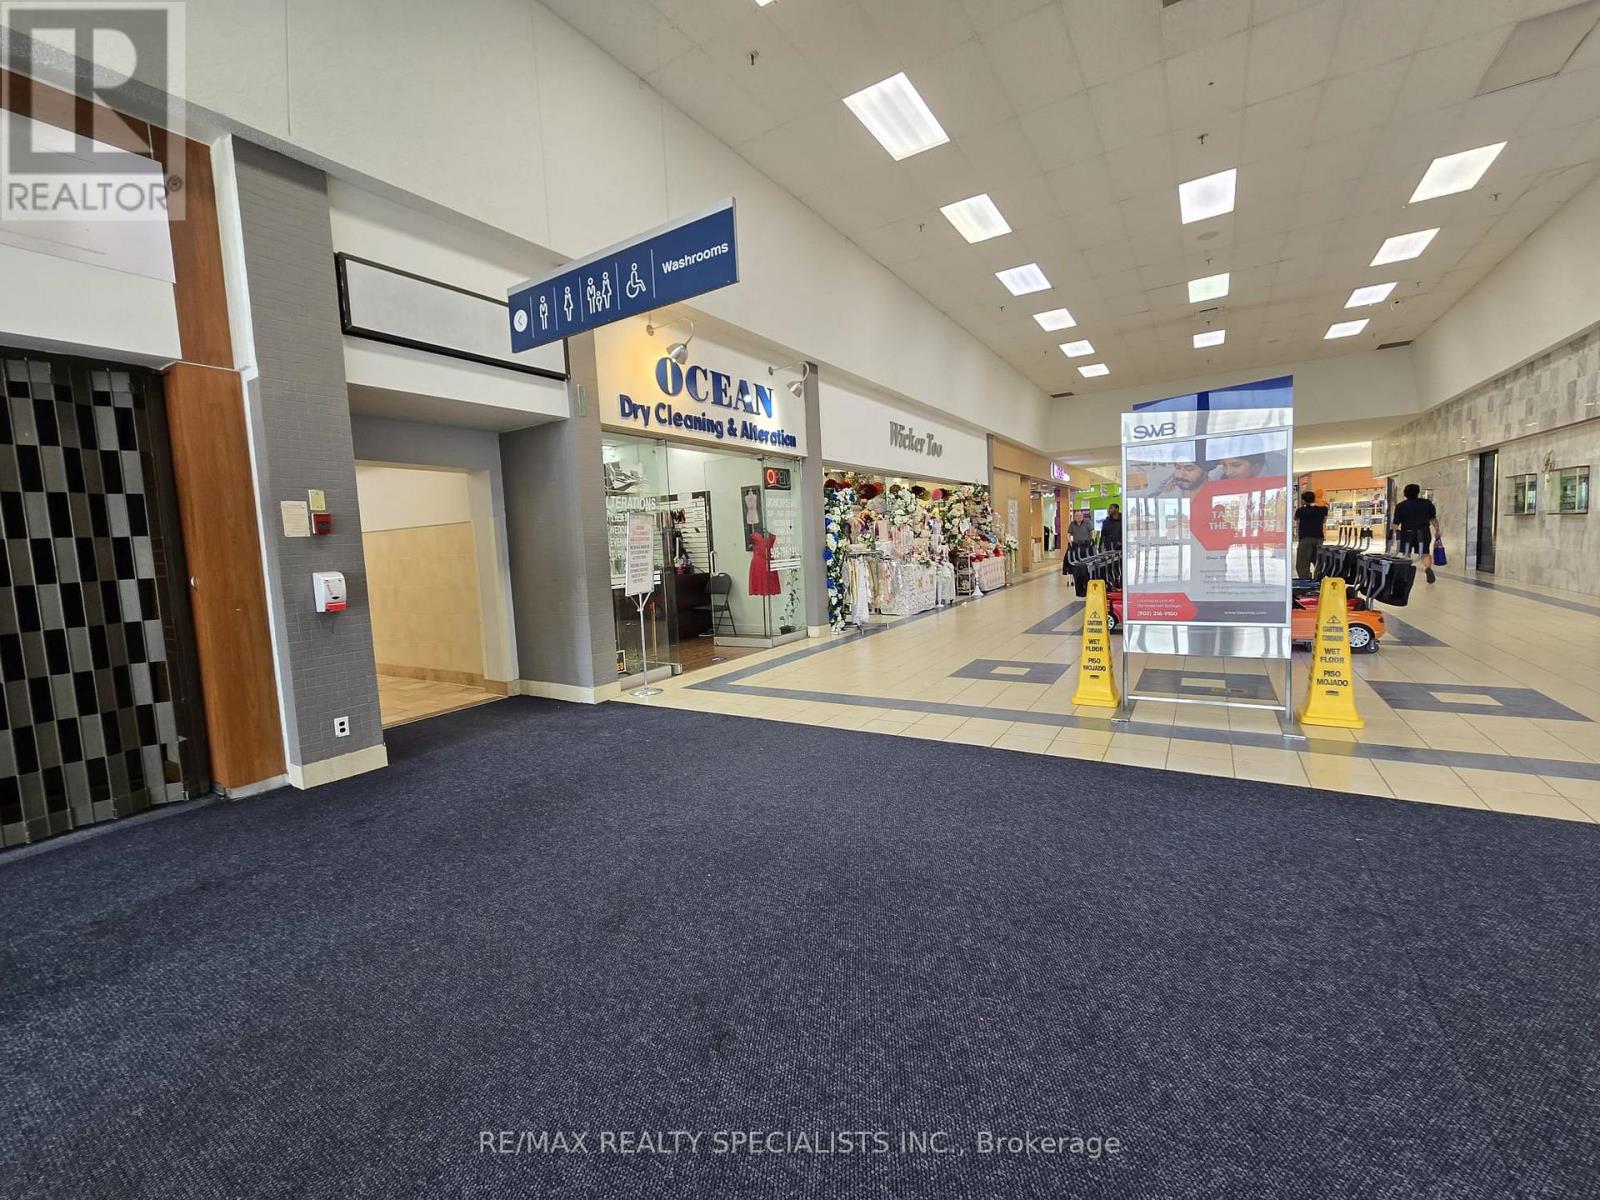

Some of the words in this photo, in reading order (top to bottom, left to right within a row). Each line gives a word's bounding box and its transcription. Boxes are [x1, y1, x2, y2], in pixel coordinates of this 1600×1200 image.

[661, 242, 729, 274] Washrooms
[655, 357, 774, 418] OCEAN
[619, 394, 651, 426] Dry
[655, 402, 723, 439] Cleaning
[727, 417, 738, 437] &
[740, 420, 797, 448] Alteration
[1133, 422, 1177, 439] SWB
[889, 420, 925, 454] Wicker
[1319, 656, 1345, 664] FLOOR
[1316, 678, 1349, 687] MOJADO
[1323, 670, 1341, 678] PISO
